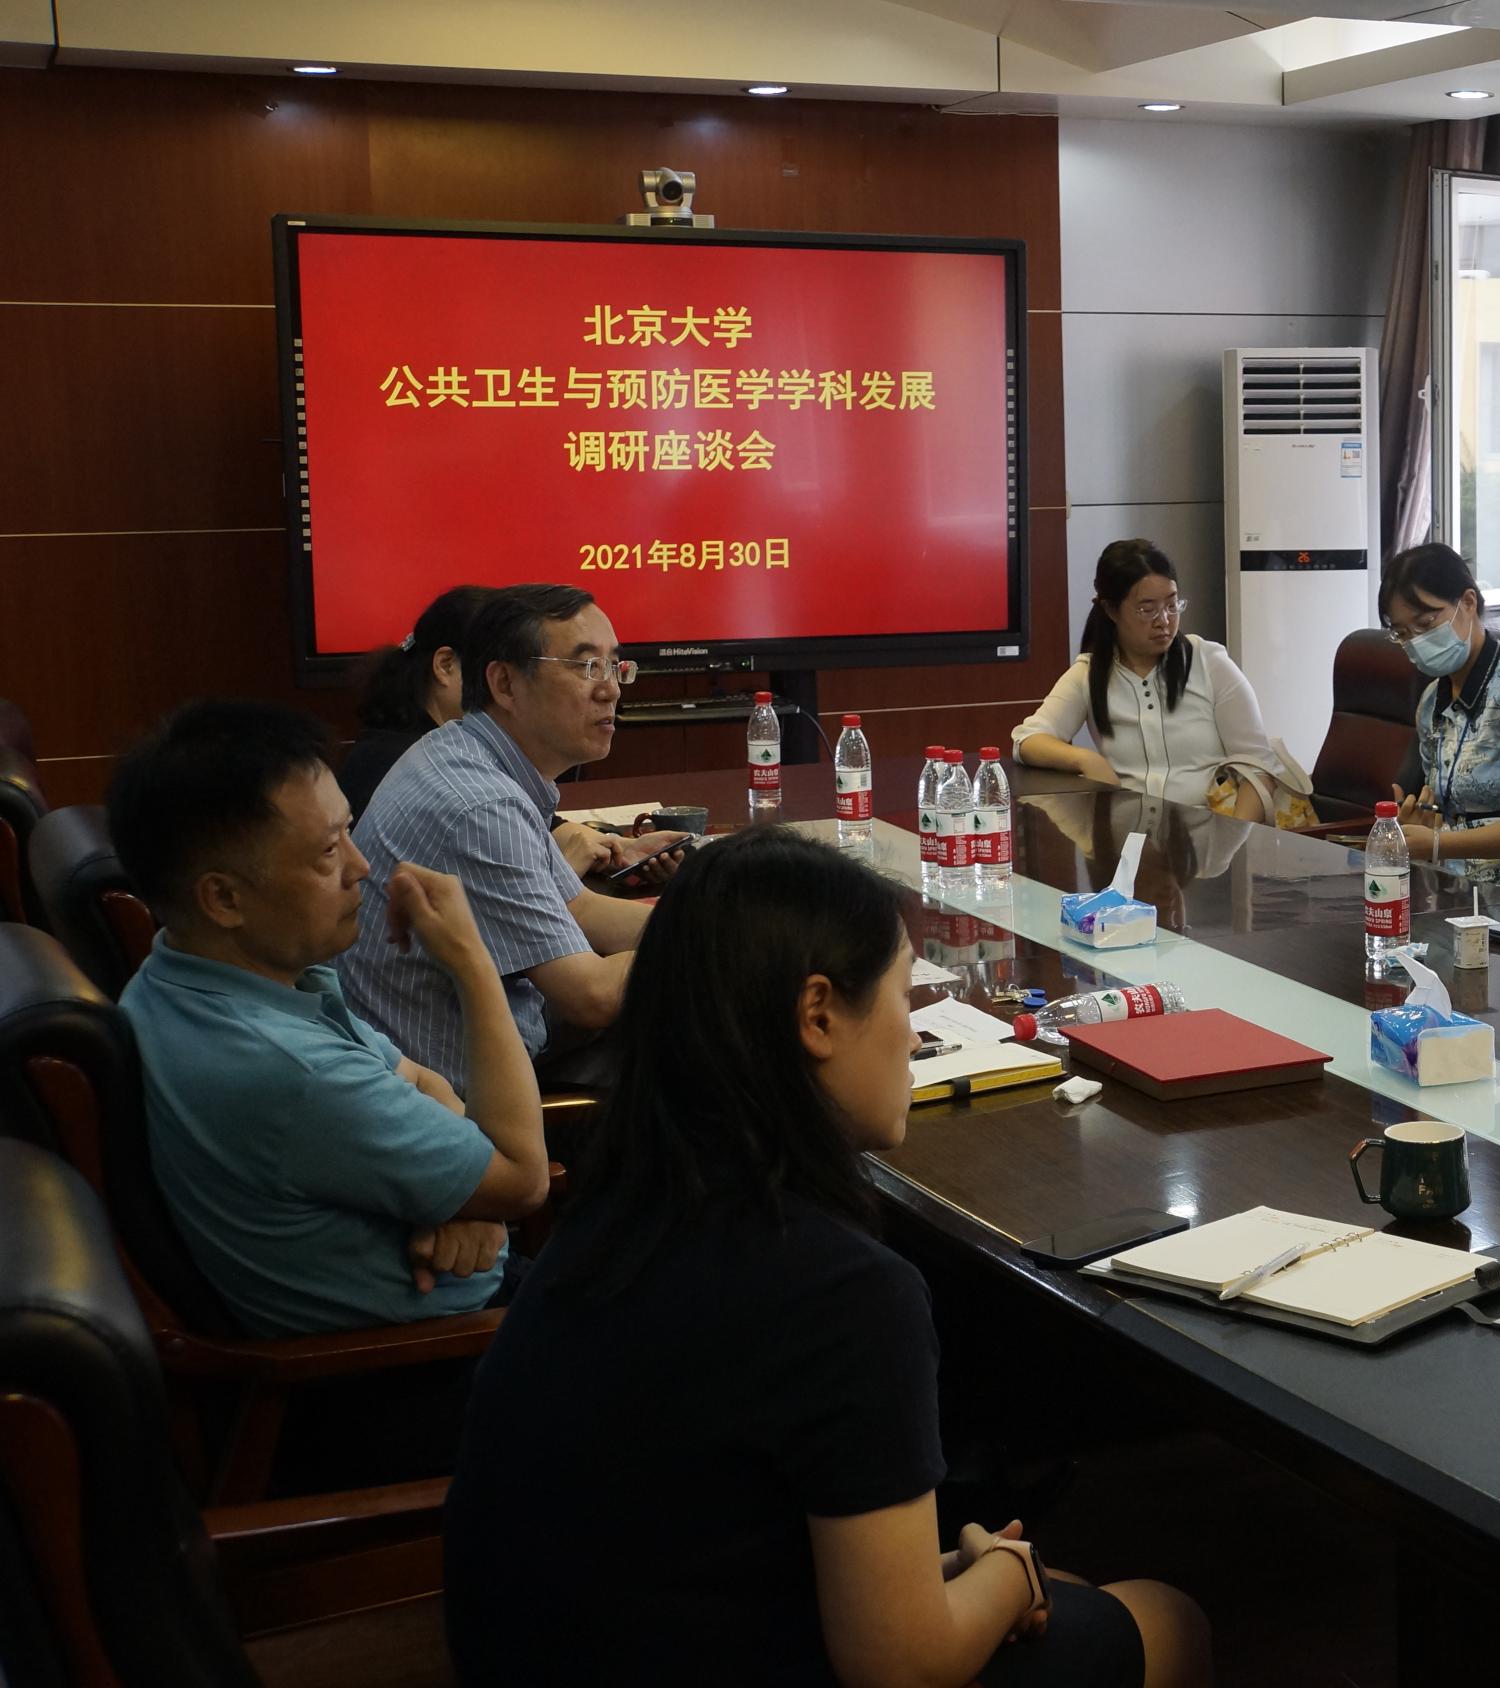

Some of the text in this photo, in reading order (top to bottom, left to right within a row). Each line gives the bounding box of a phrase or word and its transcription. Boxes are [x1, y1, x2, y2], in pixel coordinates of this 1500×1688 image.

[583, 304, 753, 349] 北京大学
[379, 365, 936, 411] 公共卫生与预防医学学科发展
[563, 429, 776, 473] 调研座谈会
[579, 538, 791, 572] 2021年8月30日
